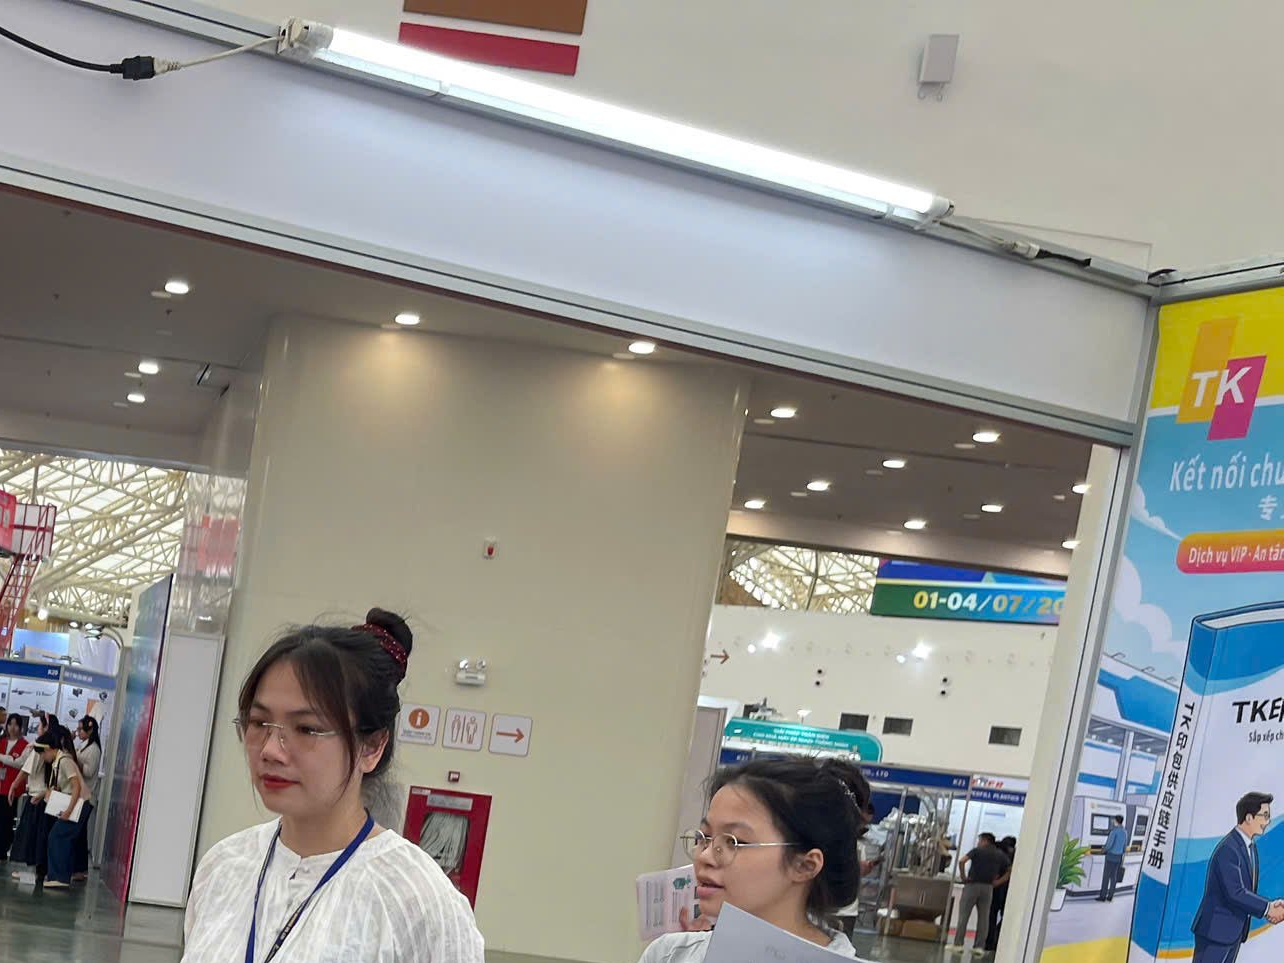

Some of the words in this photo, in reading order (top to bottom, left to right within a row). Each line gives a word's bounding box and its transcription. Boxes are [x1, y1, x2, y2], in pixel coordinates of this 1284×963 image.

[1191, 366, 1252, 408] TK
[1169, 453, 1206, 491] Kết
[1210, 450, 1247, 488] nối
[1257, 495, 1284, 520] 专
[1188, 546, 1213, 567] Dịch
[1216, 551, 1228, 567] vụ
[1231, 546, 1247, 562] VIP
[1252, 545, 1266, 561] An
